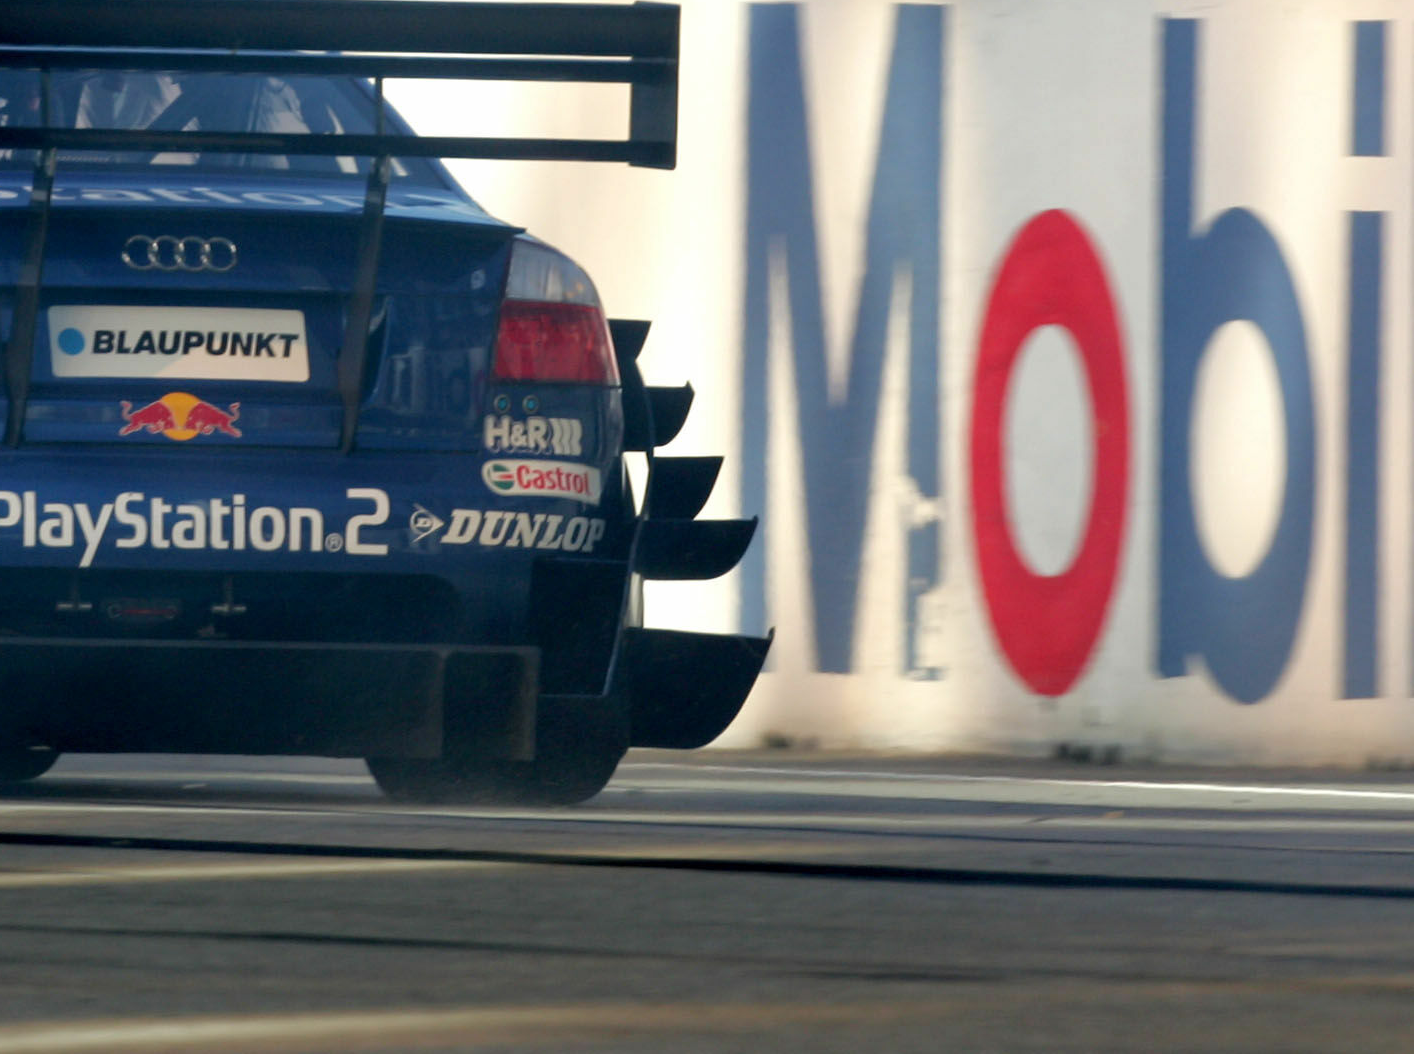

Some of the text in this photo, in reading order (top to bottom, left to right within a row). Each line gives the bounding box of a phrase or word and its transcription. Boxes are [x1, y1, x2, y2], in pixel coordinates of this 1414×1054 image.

[92, 329, 299, 358] BLAUPUNKT
[738, 1, 1414, 710] Mobi
[484, 414, 550, 452] H&R
[515, 464, 594, 496] Castrol
[439, 508, 606, 553] DUNLOP
